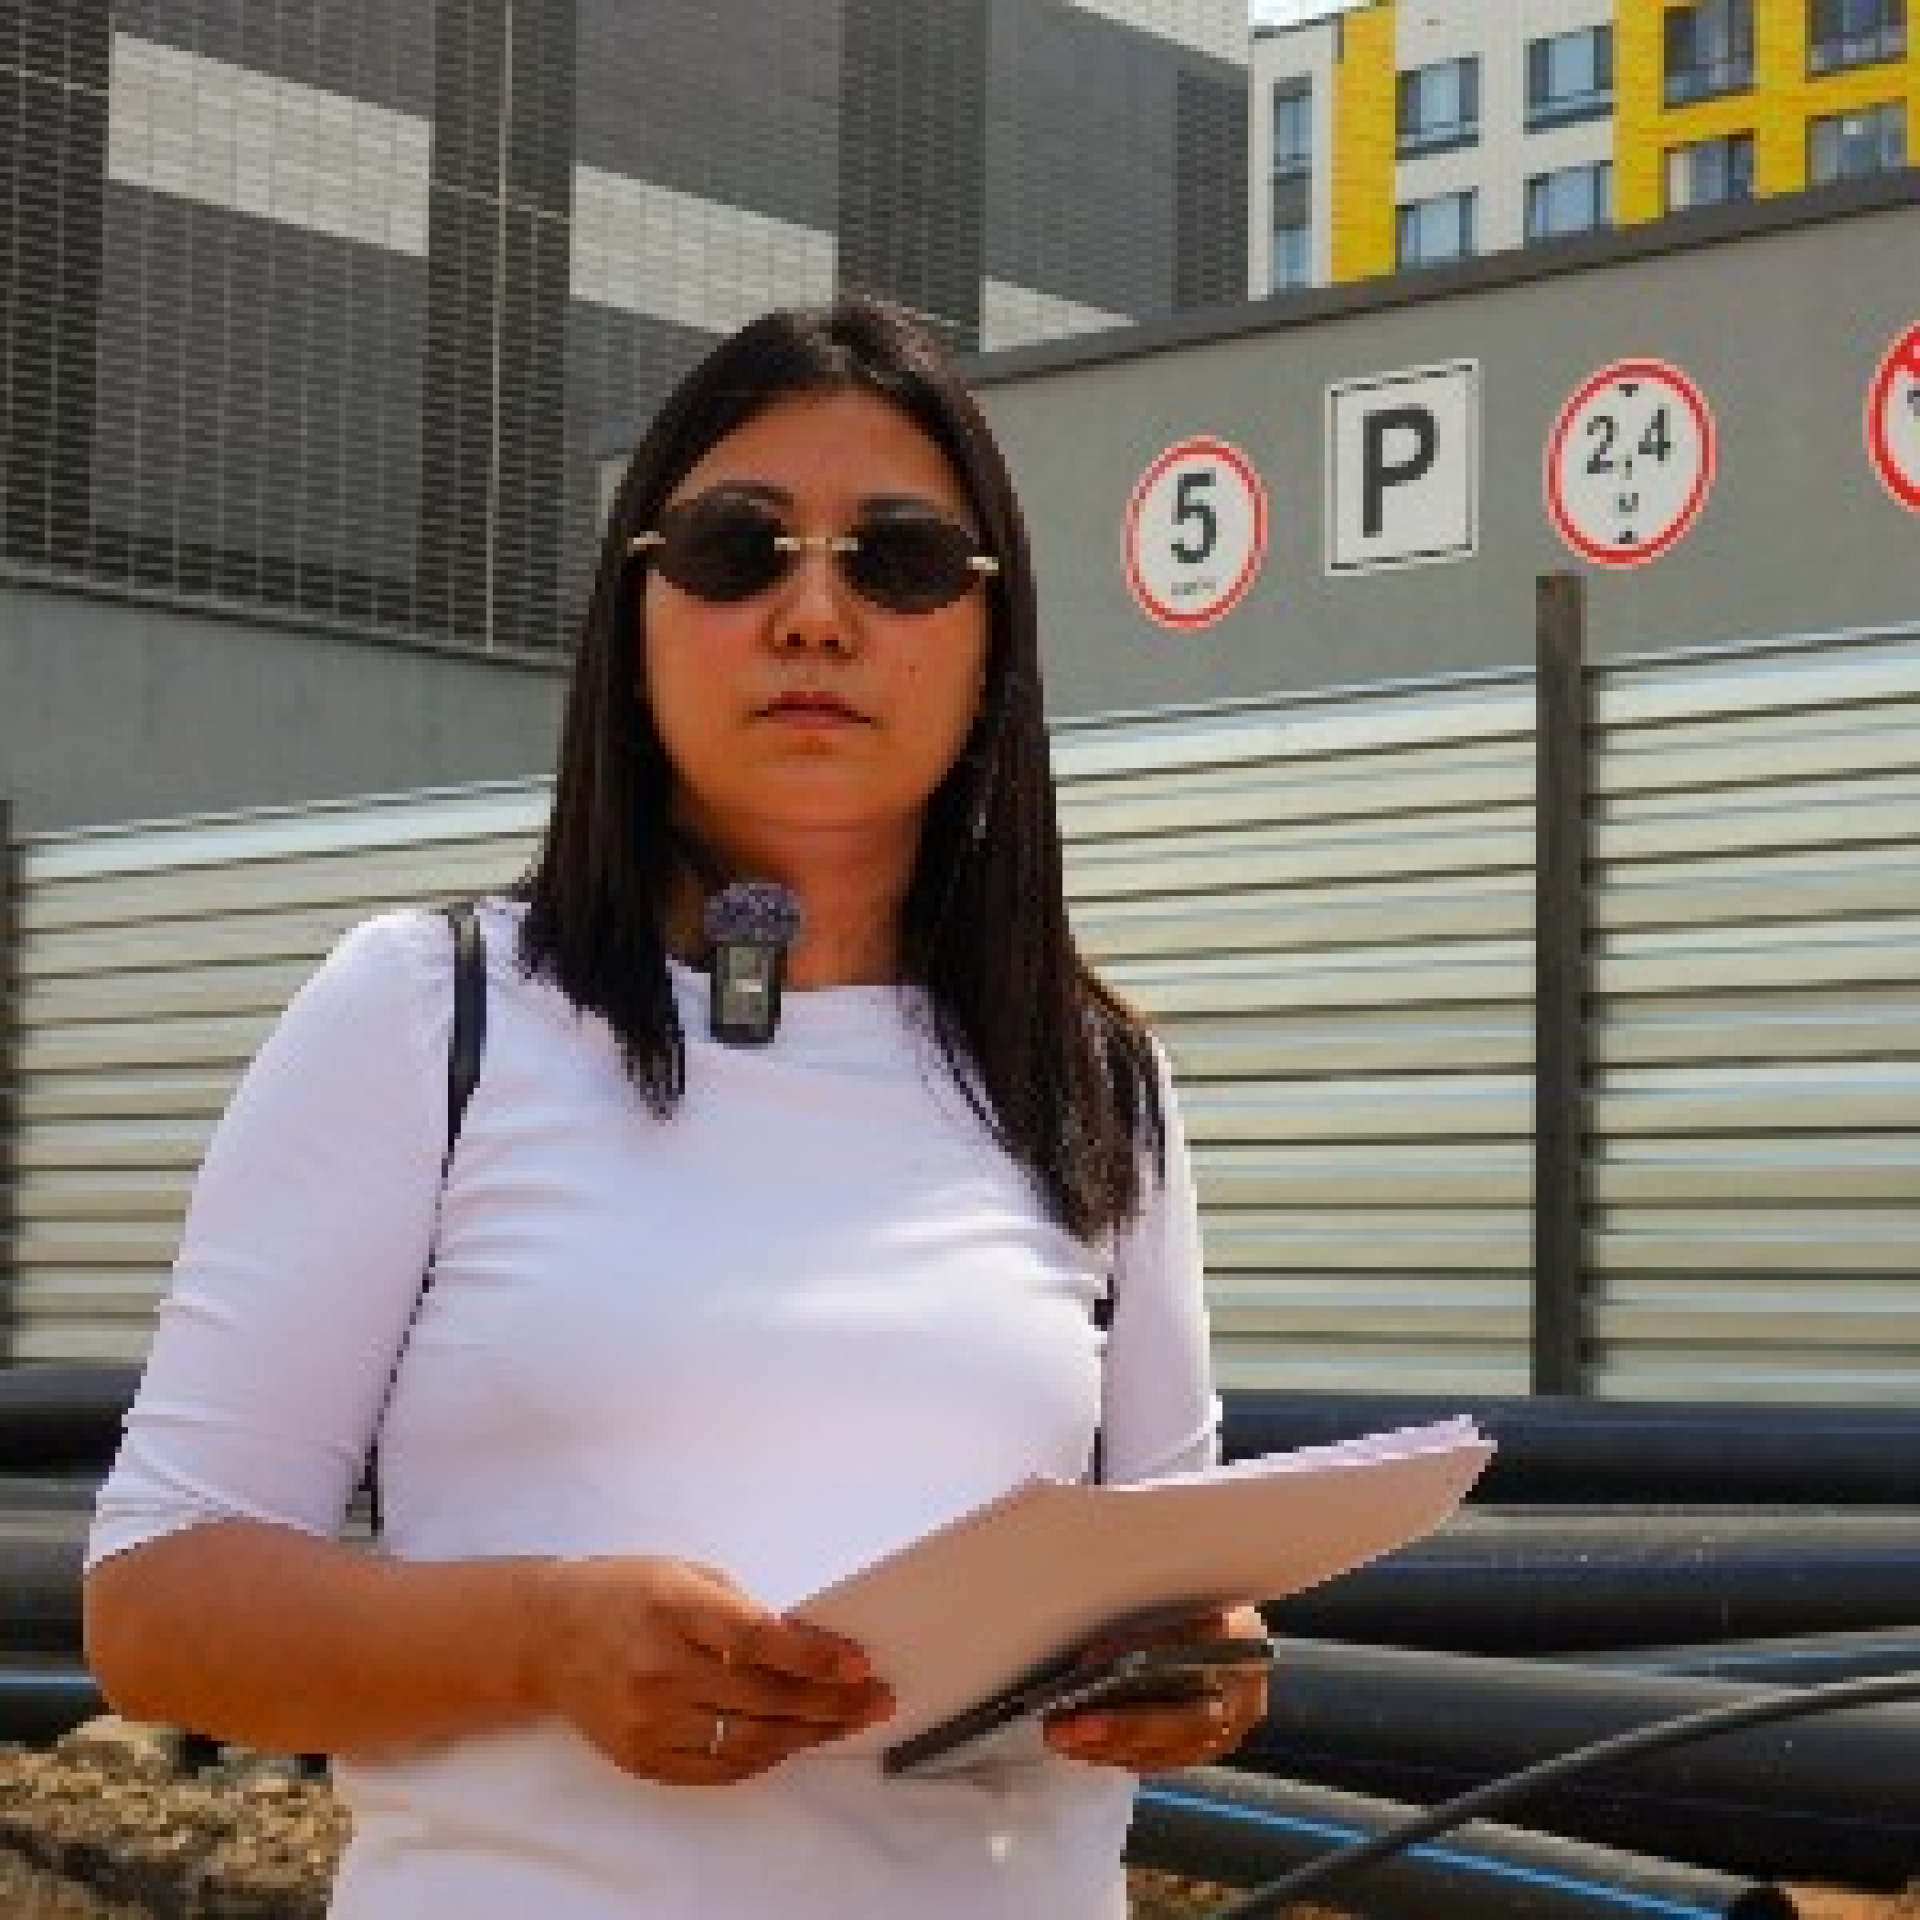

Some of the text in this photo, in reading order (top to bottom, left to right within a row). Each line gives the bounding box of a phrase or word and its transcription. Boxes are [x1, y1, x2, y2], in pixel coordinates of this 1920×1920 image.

[1362, 404, 1439, 538] P
[1586, 404, 1671, 480] 2,4
[1171, 468, 1216, 564] 5
